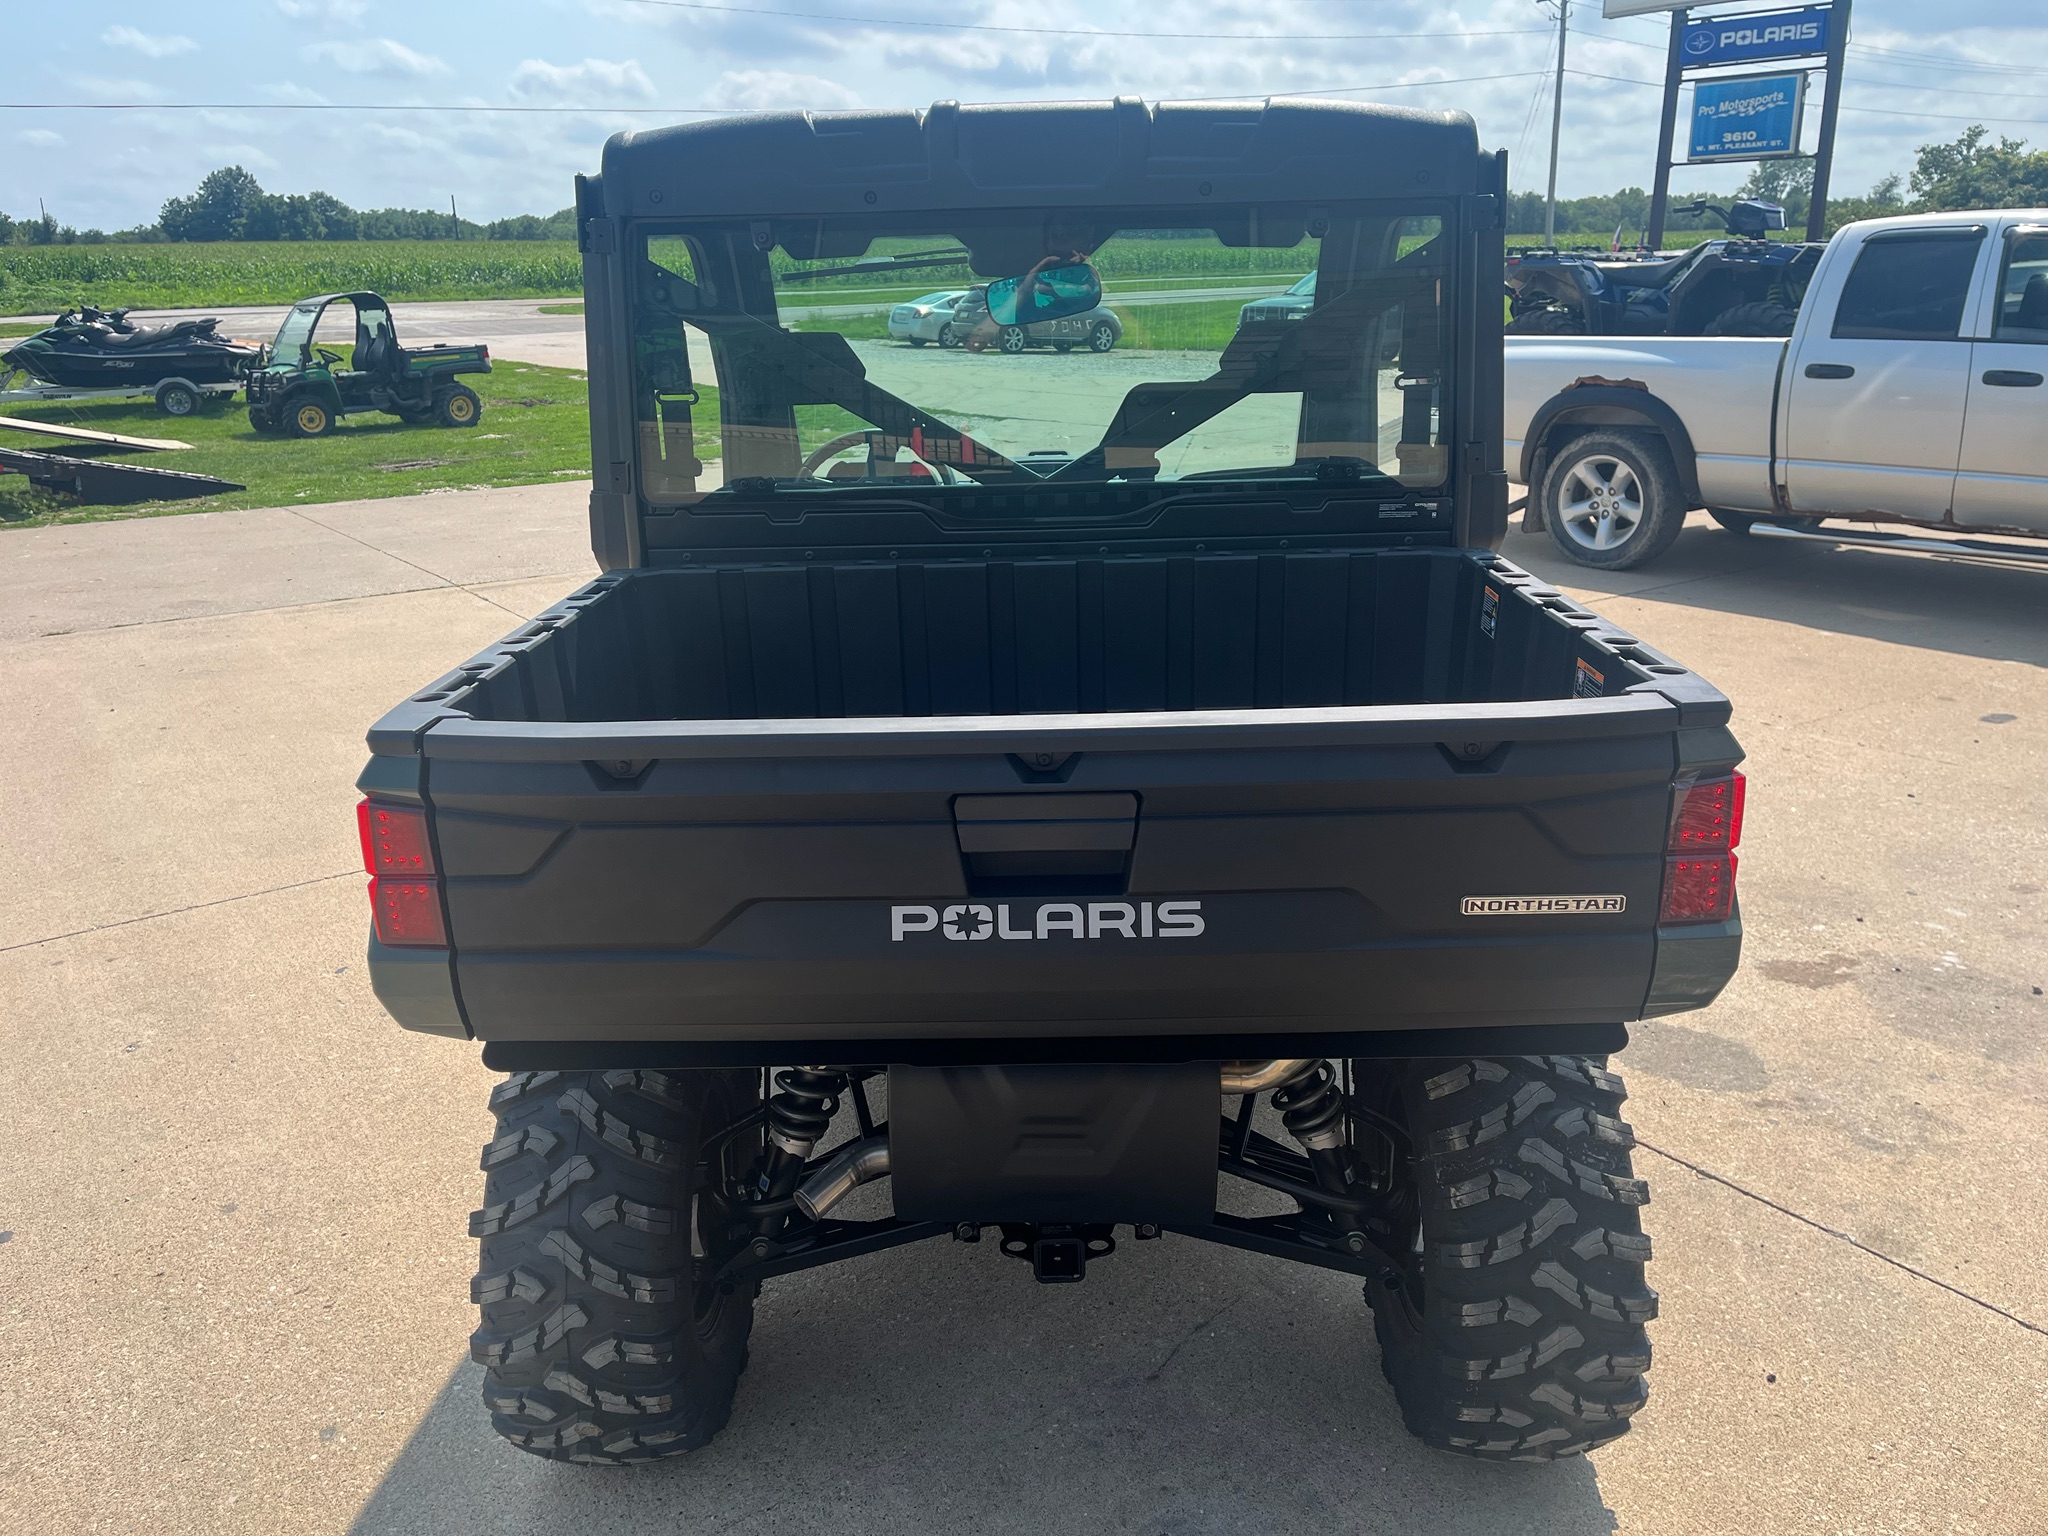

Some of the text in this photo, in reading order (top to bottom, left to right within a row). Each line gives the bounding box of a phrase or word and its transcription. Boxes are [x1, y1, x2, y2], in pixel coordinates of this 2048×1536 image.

[1720, 22, 1818, 47] POLARIS
[1698, 91, 1784, 116] Pro Motorsports
[1722, 130, 1757, 142] 3610
[1725, 140, 1768, 149] PLEASANT
[1771, 139, 1784, 147] ST.
[1470, 899, 1618, 912] NORTHSTAR
[891, 901, 1206, 941] POLARIS
